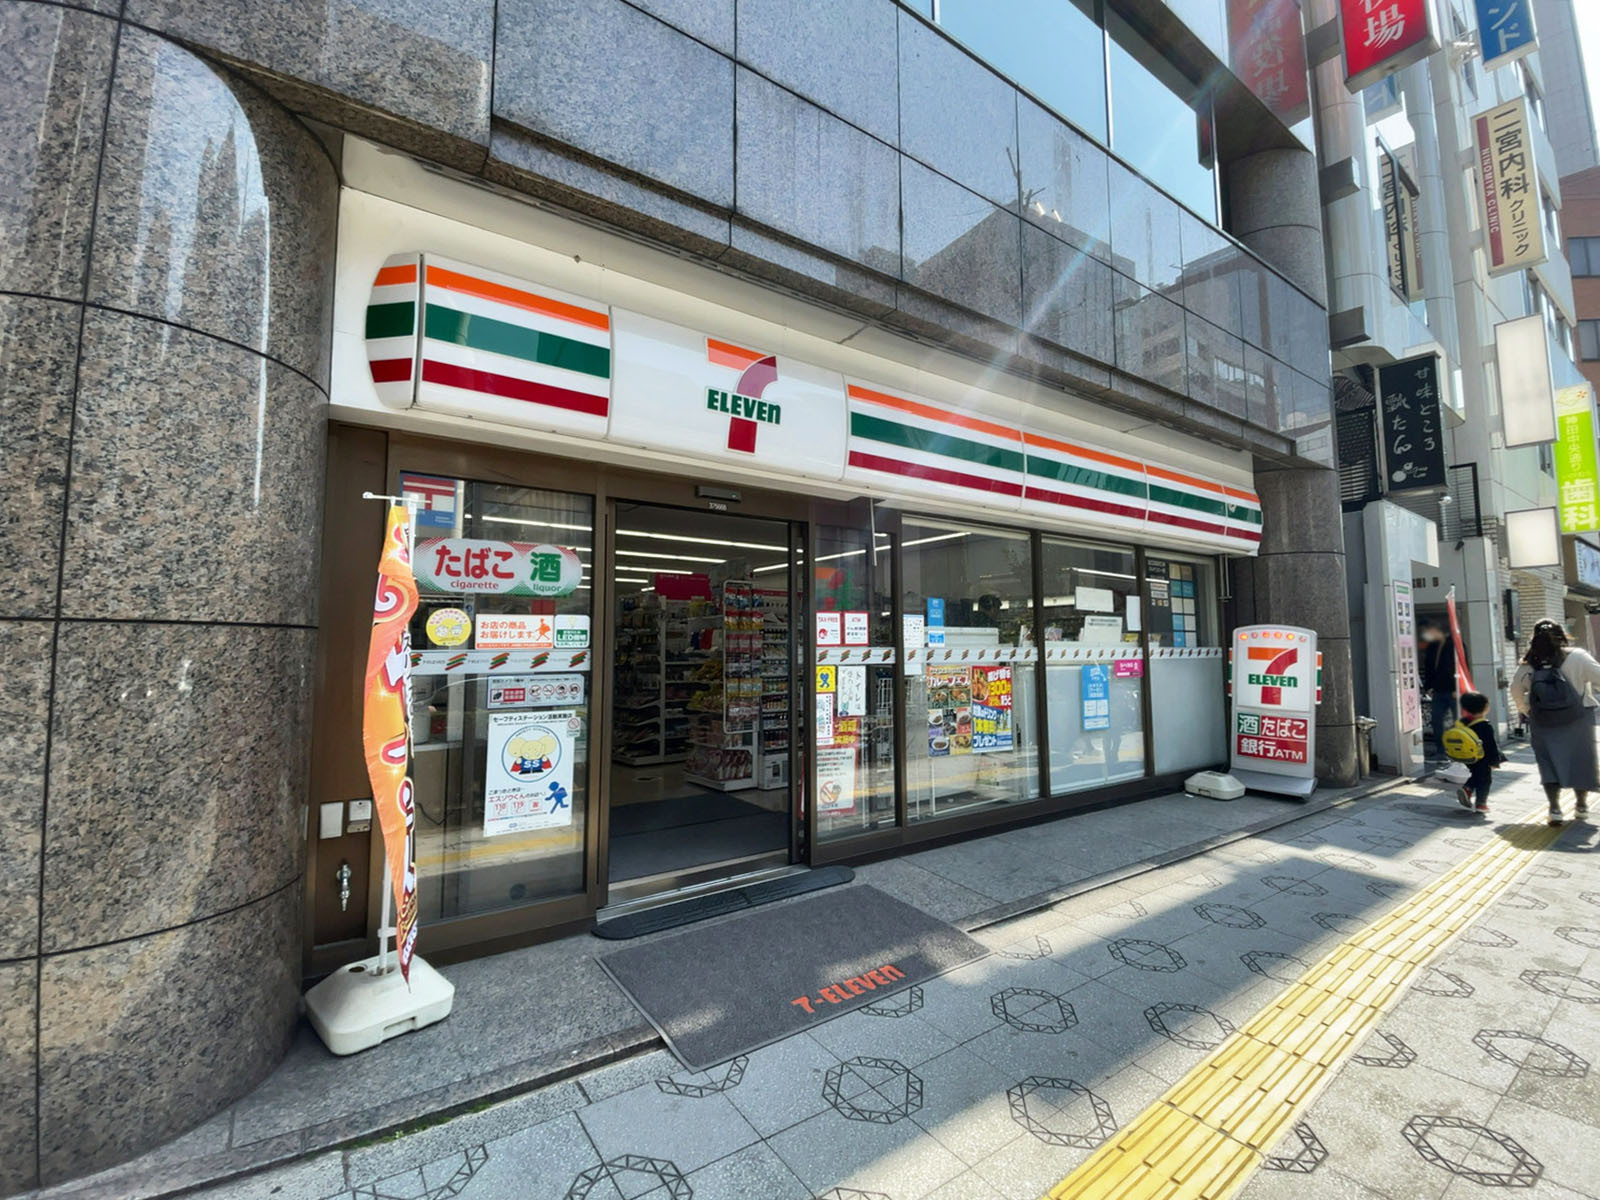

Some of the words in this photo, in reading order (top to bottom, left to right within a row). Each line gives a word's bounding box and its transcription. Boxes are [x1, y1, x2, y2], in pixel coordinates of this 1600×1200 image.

[1359, 0, 1405, 49] 場
[1493, 107, 1530, 257] 二宮内科クリニック
[1487, 199, 1499, 234] CLINIC
[707, 338, 778, 453] 7
[1414, 366, 1437, 451] 甘味どころ
[1561, 478, 1600, 531] 歯科
[434, 545, 515, 579] たばこ
[530, 551, 562, 582] 酒
[450, 580, 499, 590] cigarette
[532, 583, 562, 593] liquor
[927, 675, 970, 689] カレーフェス
[1248, 647, 1298, 705] 7
[972, 734, 997, 748] プレゼント
[1239, 714, 1259, 735] 酒
[1262, 717, 1306, 739] たばこ
[1241, 738, 1303, 761] 銀行ATM
